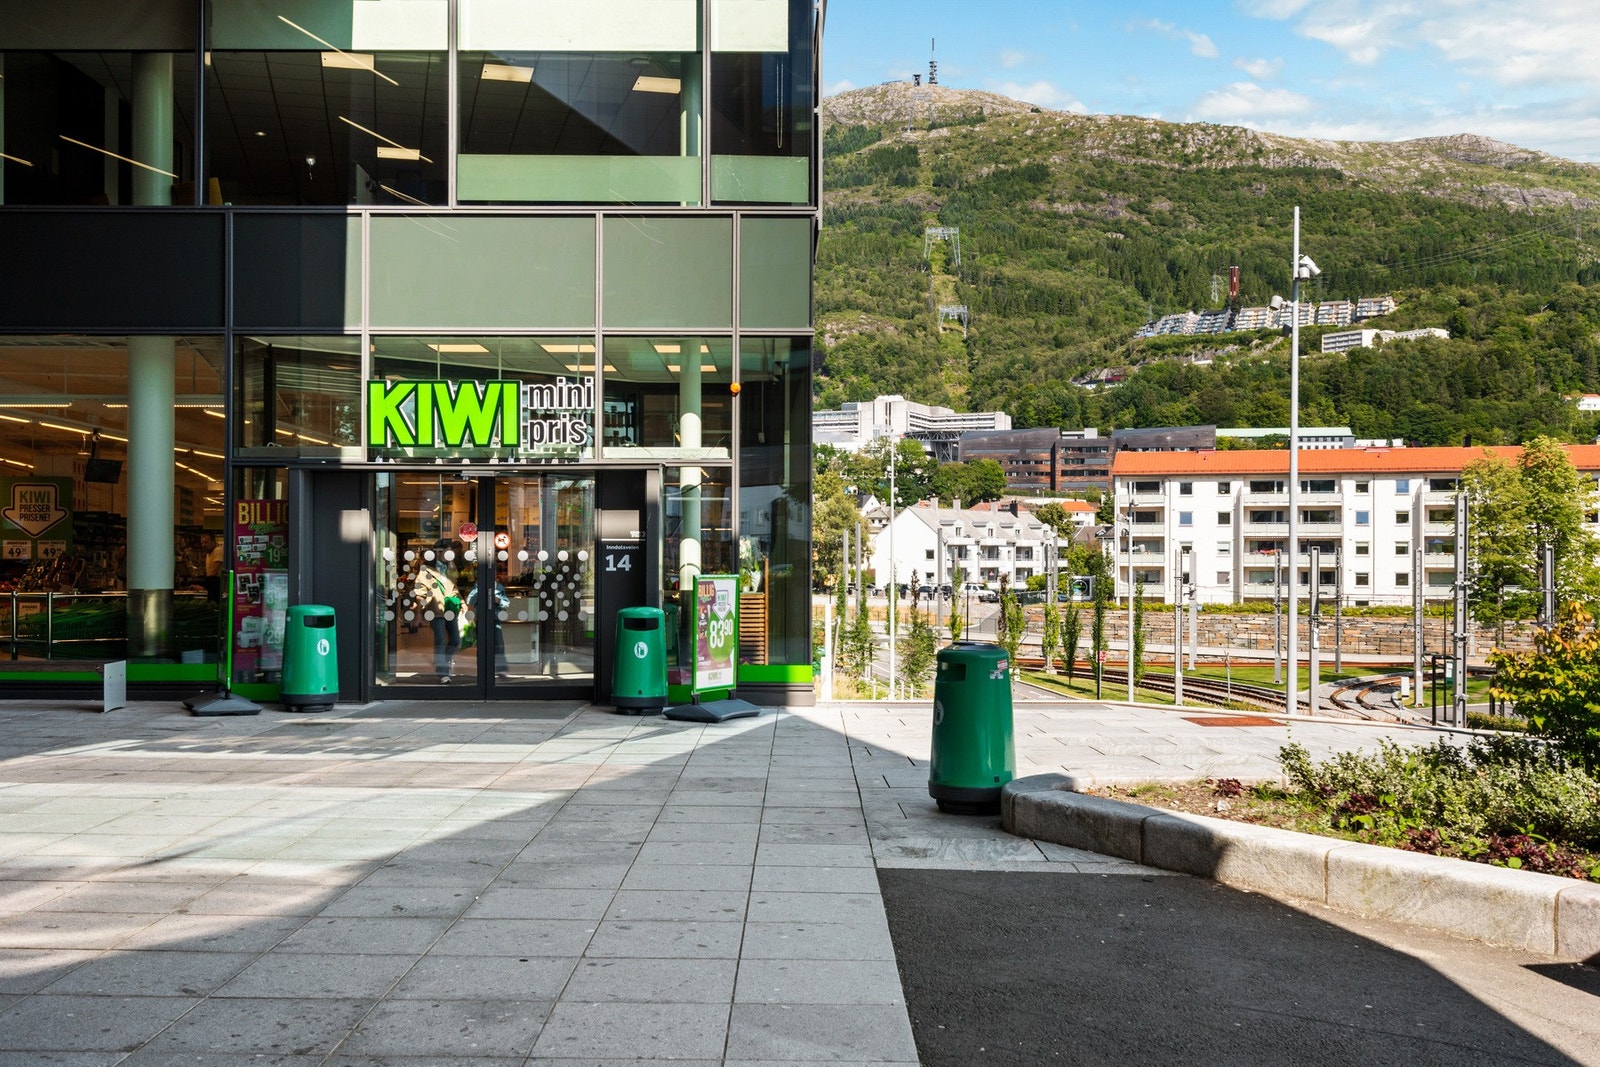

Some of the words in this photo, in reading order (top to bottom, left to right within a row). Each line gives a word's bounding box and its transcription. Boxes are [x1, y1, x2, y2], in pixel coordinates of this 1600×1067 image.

[528, 377, 594, 410] mini
[367, 380, 520, 447] KIWI
[528, 413, 587, 451] pris
[19, 491, 51, 503] KIWI
[19, 504, 51, 513] PRESSER
[605, 554, 632, 572] 14
[709, 620, 725, 649] 83
